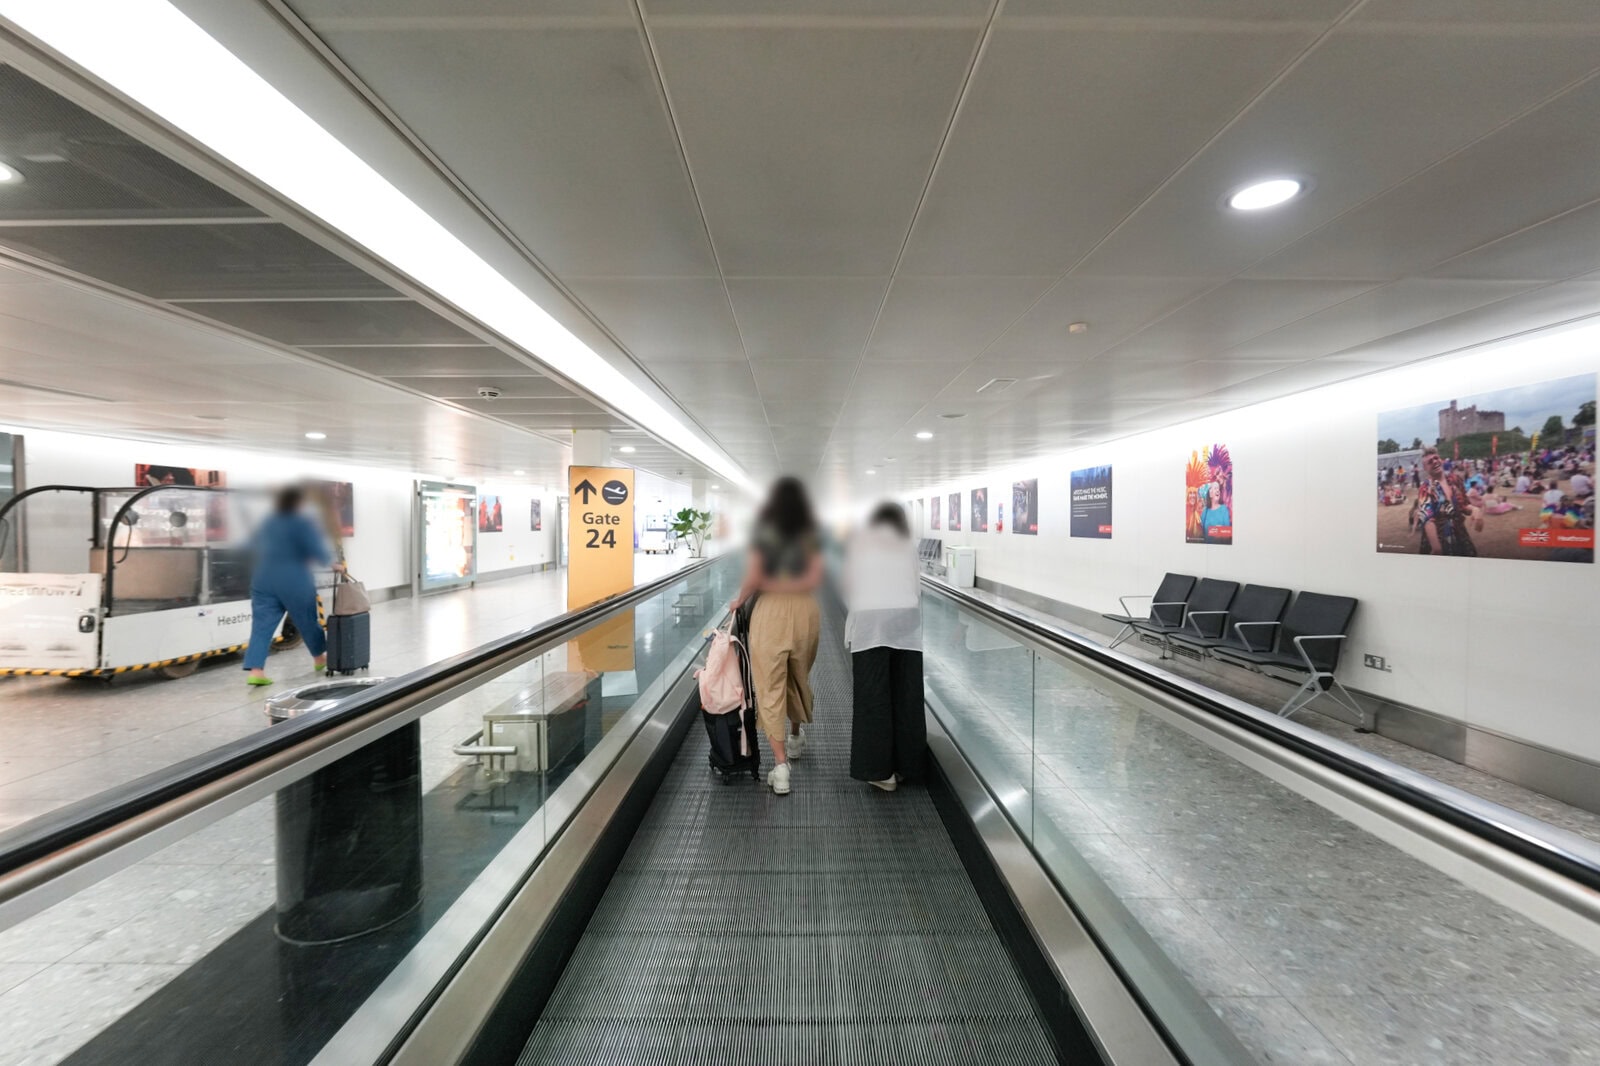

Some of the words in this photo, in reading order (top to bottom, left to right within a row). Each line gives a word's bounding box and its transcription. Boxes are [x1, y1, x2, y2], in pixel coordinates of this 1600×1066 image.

[582, 511, 620, 525] Gate
[586, 529, 617, 549] 24
[217, 613, 252, 626] Heathr
